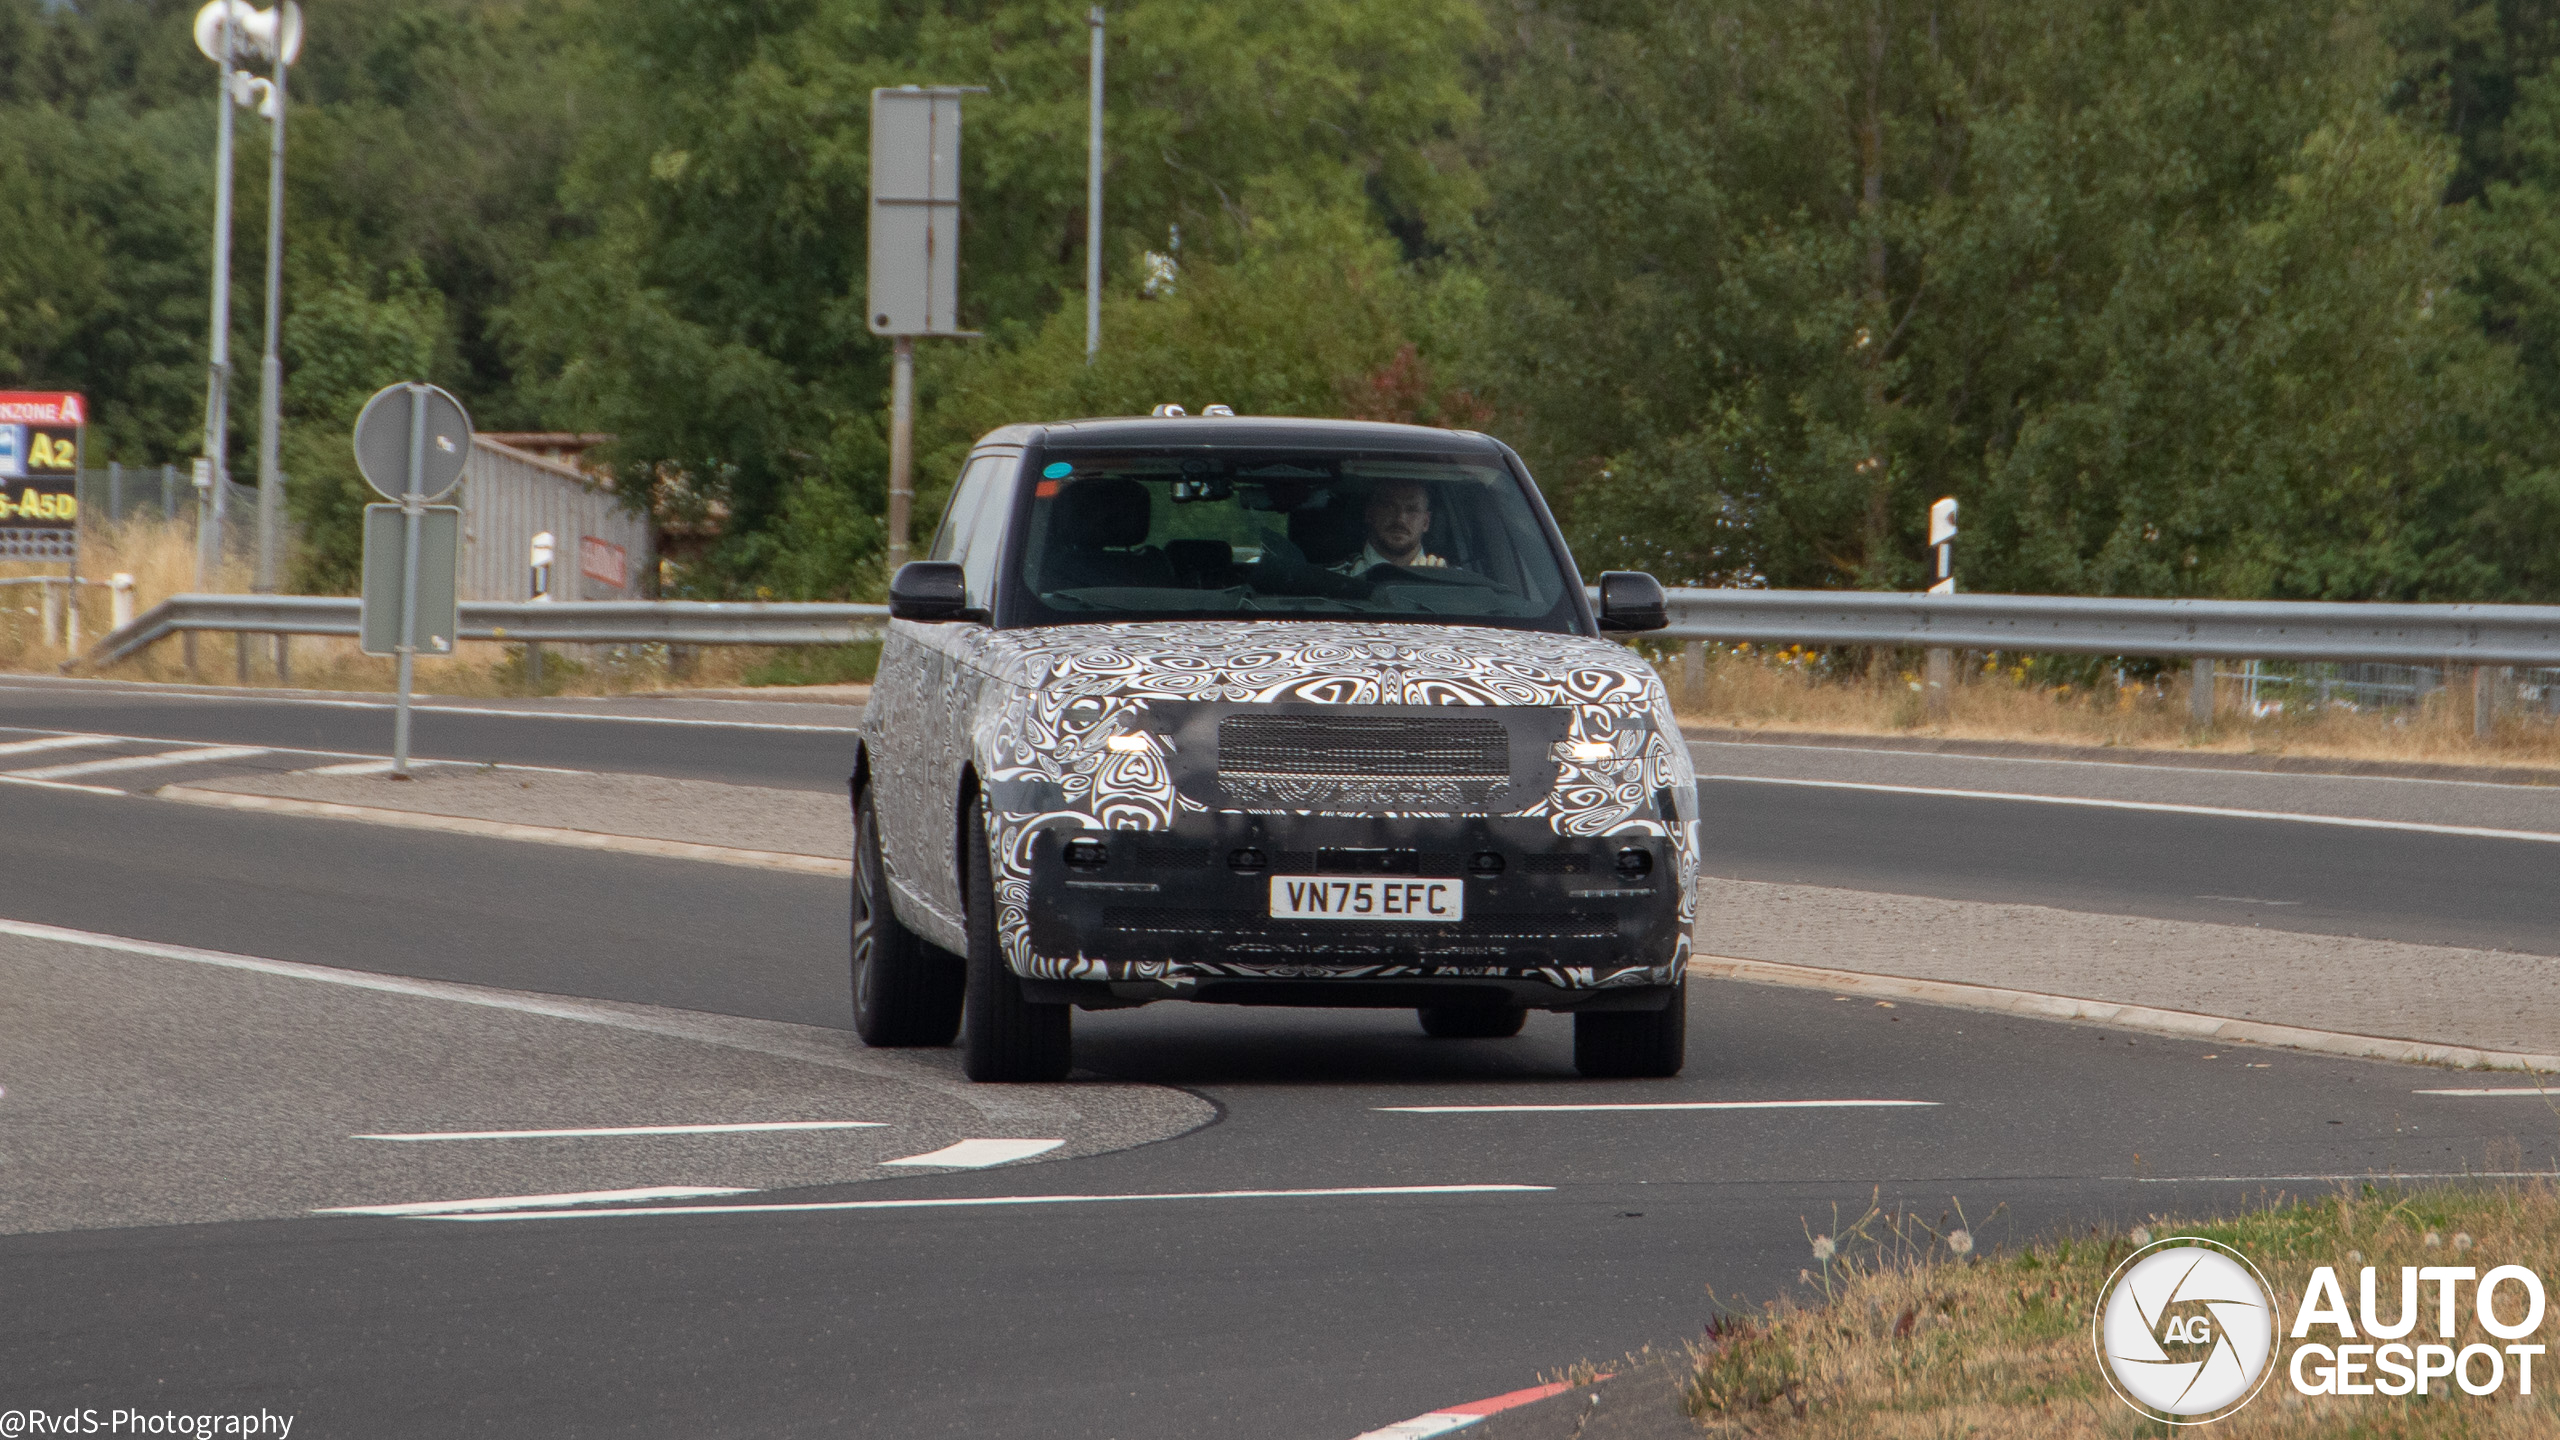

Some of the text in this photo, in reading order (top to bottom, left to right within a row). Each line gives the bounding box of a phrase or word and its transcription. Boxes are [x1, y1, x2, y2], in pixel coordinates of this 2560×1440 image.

[60, 395, 82, 422] A
[28, 432, 76, 468] A2
[1287, 882, 1447, 914] VN75 EFC
